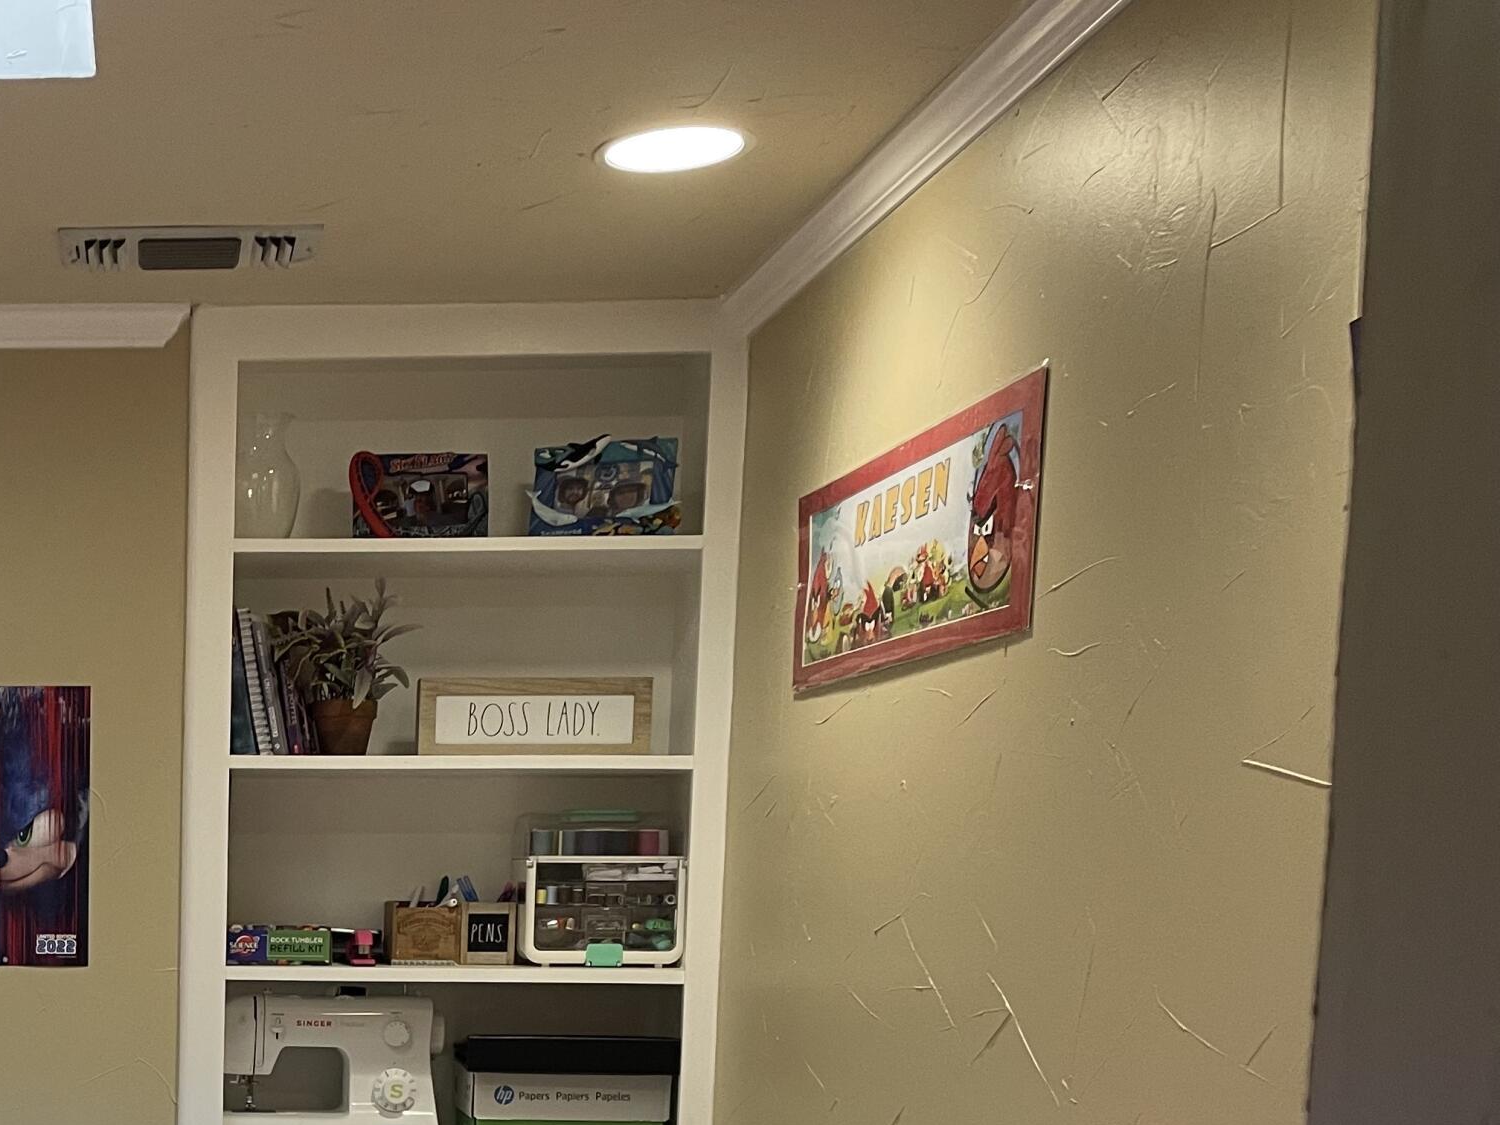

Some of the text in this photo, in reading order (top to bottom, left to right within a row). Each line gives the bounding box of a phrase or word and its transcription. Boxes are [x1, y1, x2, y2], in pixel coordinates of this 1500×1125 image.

[854, 457, 951, 548] KAESEN
[467, 701, 531, 737] BOSS
[470, 923, 503, 943] PENS
[36, 939, 77, 954] 2022
[229, 940, 259, 949] SCIENCE
[270, 944, 324, 953] REFILL KIT
[494, 1086, 631, 1105] hp Papers Papiers Papeles
